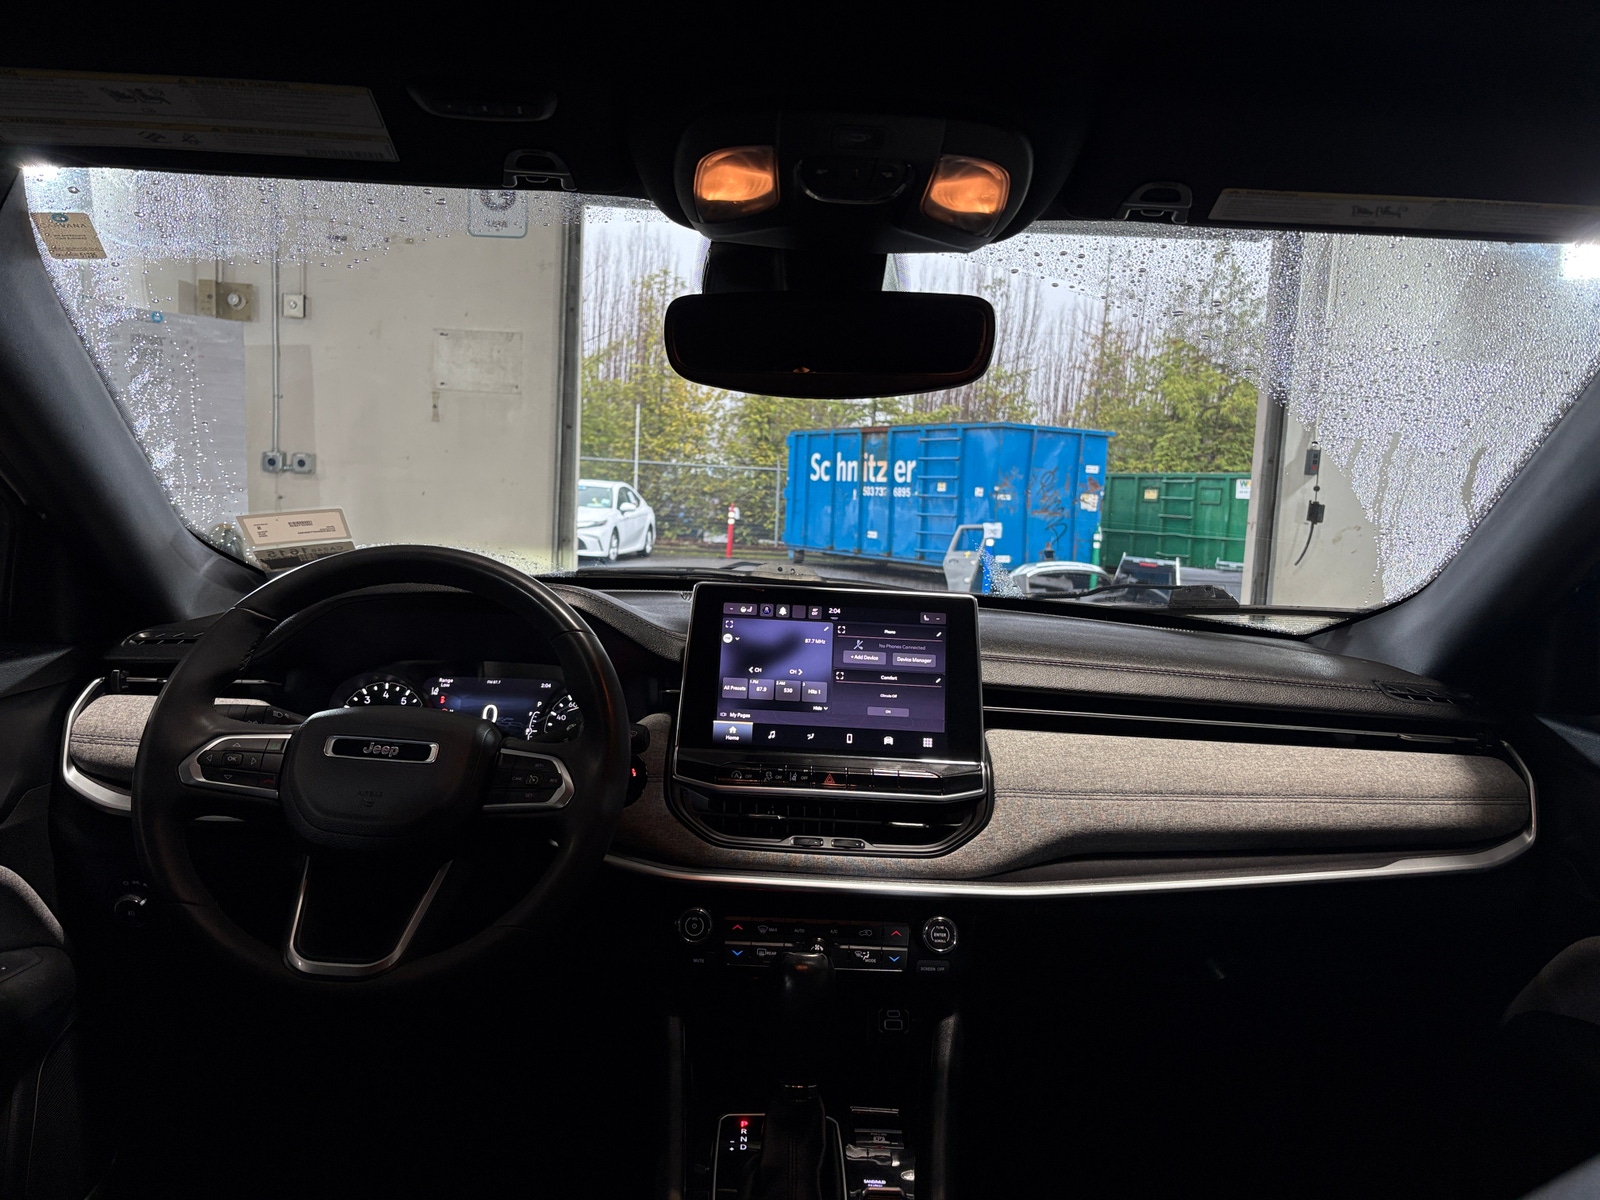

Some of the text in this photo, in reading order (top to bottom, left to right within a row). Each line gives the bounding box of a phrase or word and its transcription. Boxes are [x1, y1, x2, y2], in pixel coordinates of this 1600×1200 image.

[810, 451, 917, 483] Schnitzer
[382, 690, 389, 699] 4
[363, 695, 371, 704] 3
[400, 696, 407, 705] 5
[362, 741, 400, 757] Jeep
